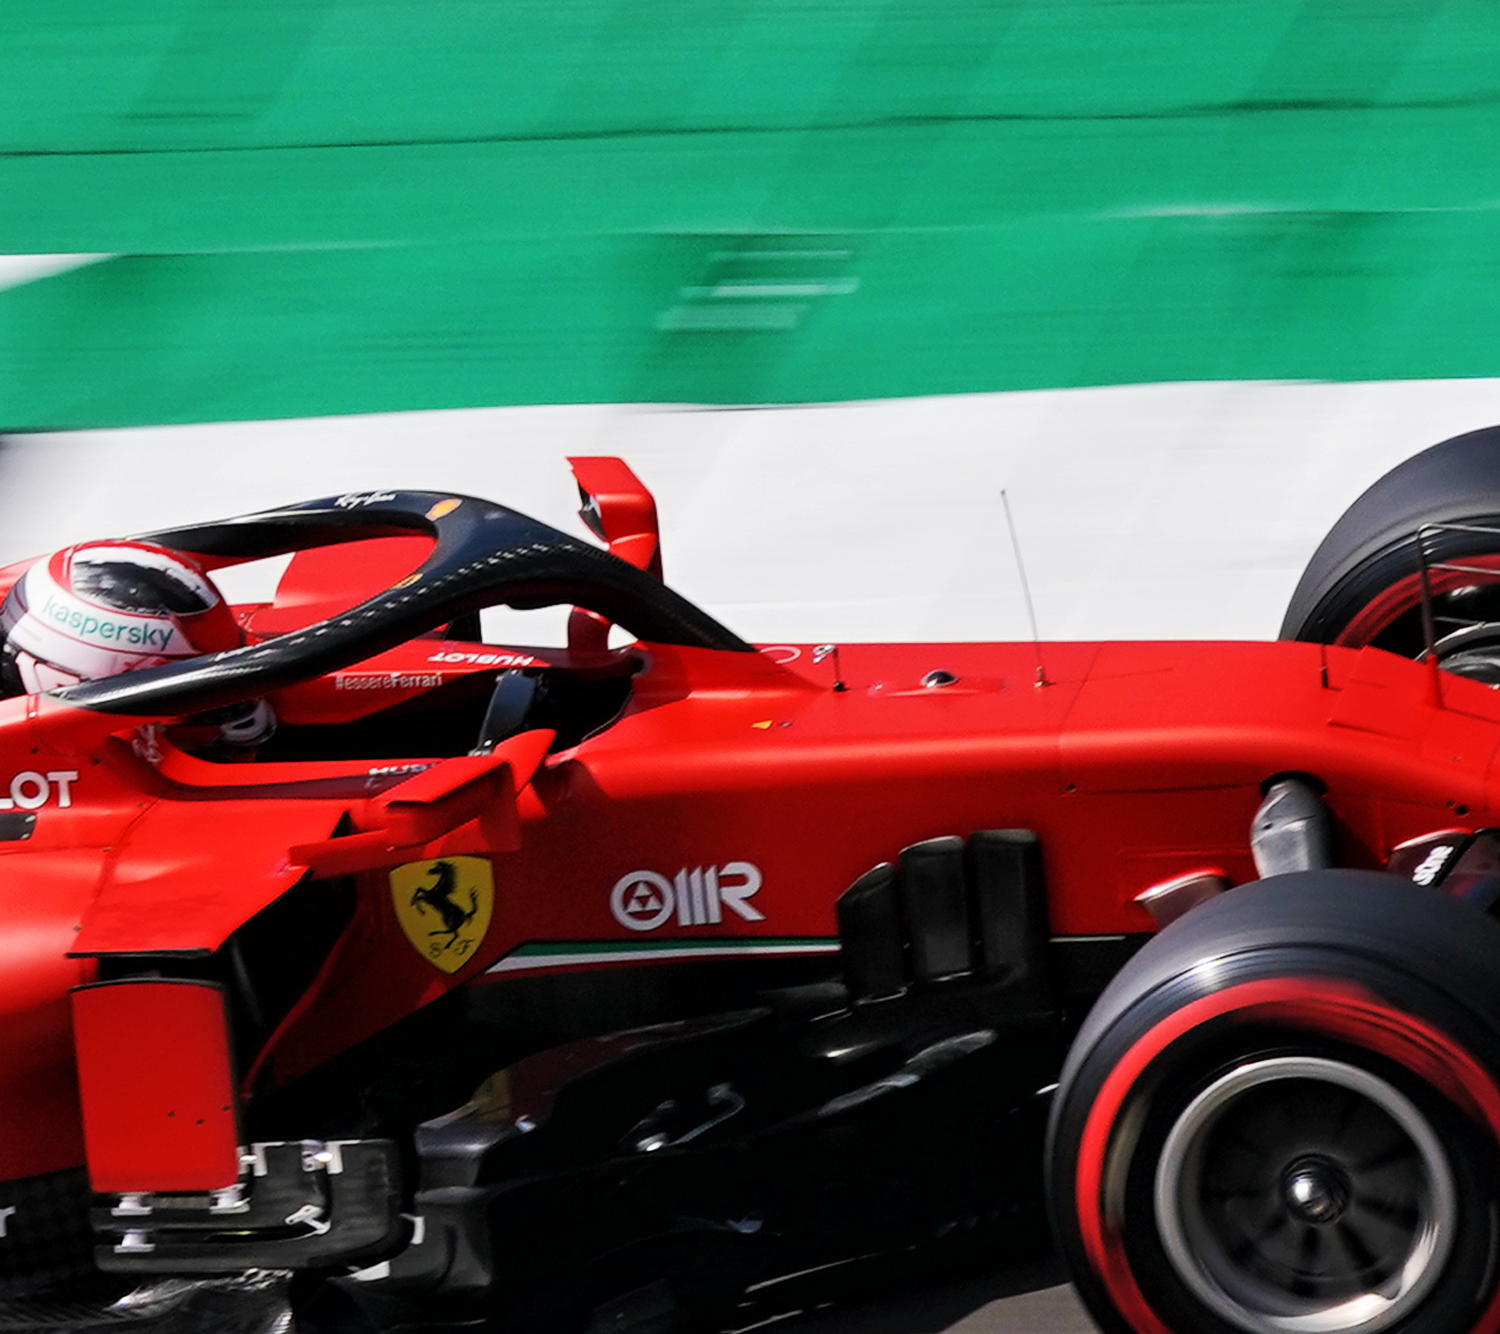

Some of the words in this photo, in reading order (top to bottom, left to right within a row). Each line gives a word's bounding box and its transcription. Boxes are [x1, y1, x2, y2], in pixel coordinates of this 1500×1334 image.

[43, 594, 174, 651] kaspersky
[427, 652, 534, 666] HUBLOT
[335, 671, 442, 690] #essereFerrari
